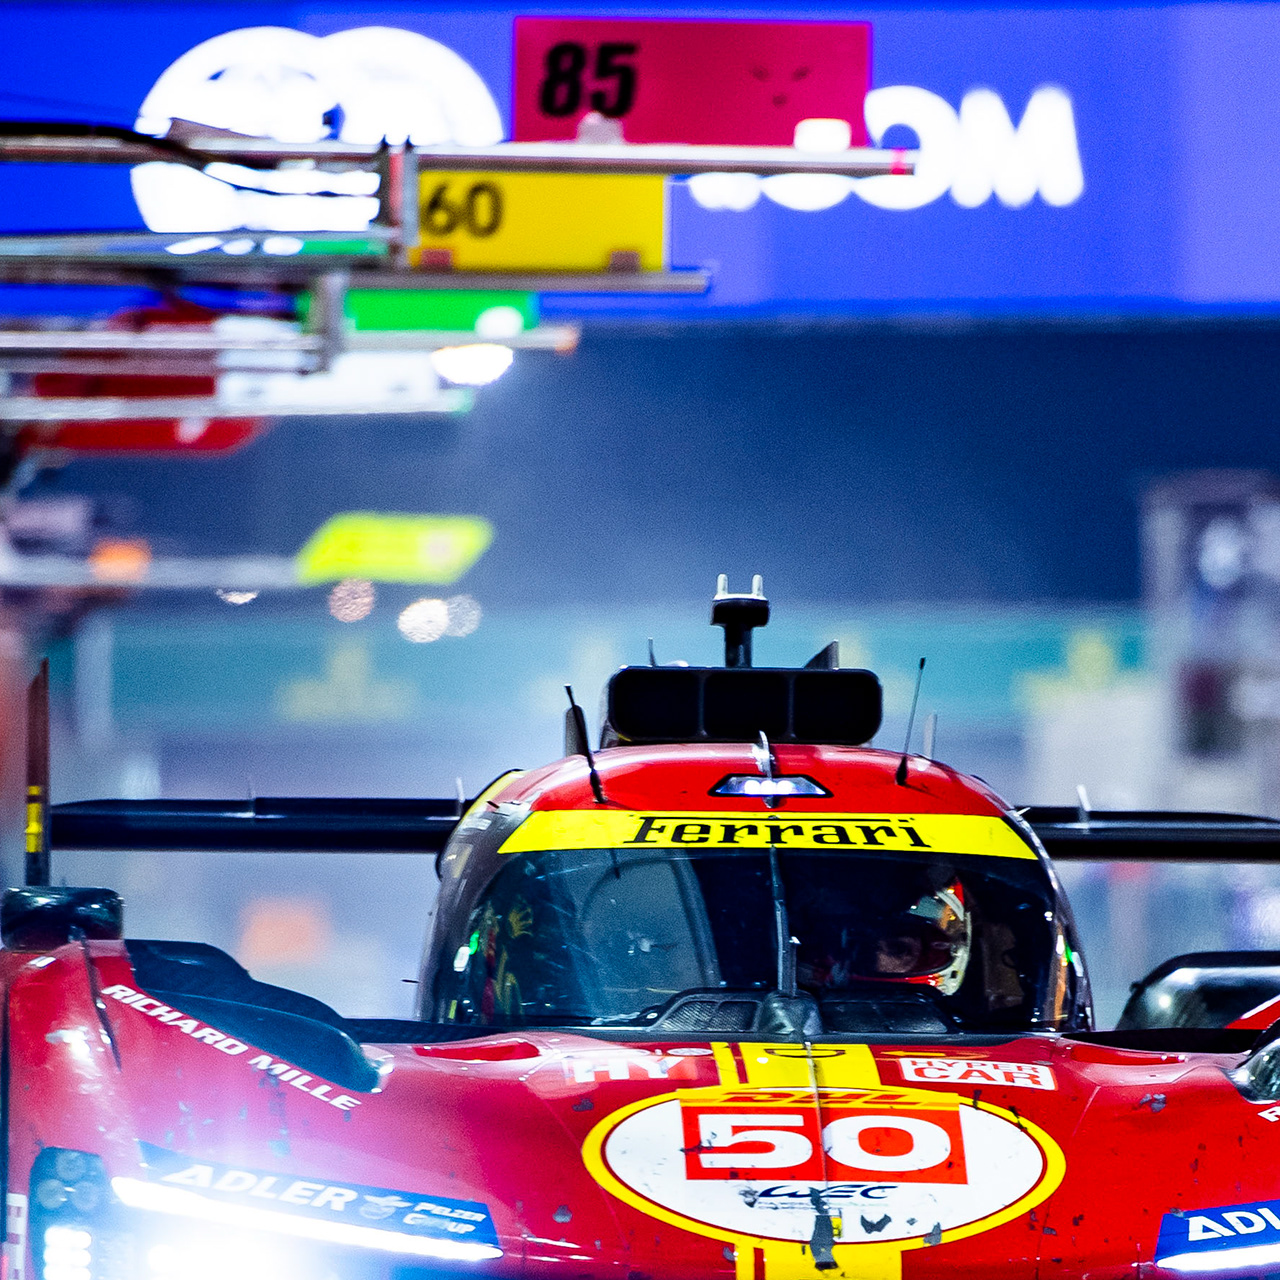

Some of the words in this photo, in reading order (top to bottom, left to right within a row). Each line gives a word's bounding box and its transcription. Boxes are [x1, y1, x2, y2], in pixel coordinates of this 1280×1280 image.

[539, 41, 639, 118] 85
[421, 180, 505, 239] 60
[623, 816, 932, 849] Ferrari
[100, 984, 249, 1056] RICHARD
[247, 1054, 362, 1111] MILLE
[910, 1060, 1040, 1074] HYPER
[913, 1066, 1043, 1086] CAR
[697, 1113, 952, 1172] 50
[160, 1164, 359, 1212] ADLER
[757, 1184, 899, 1200] WEC
